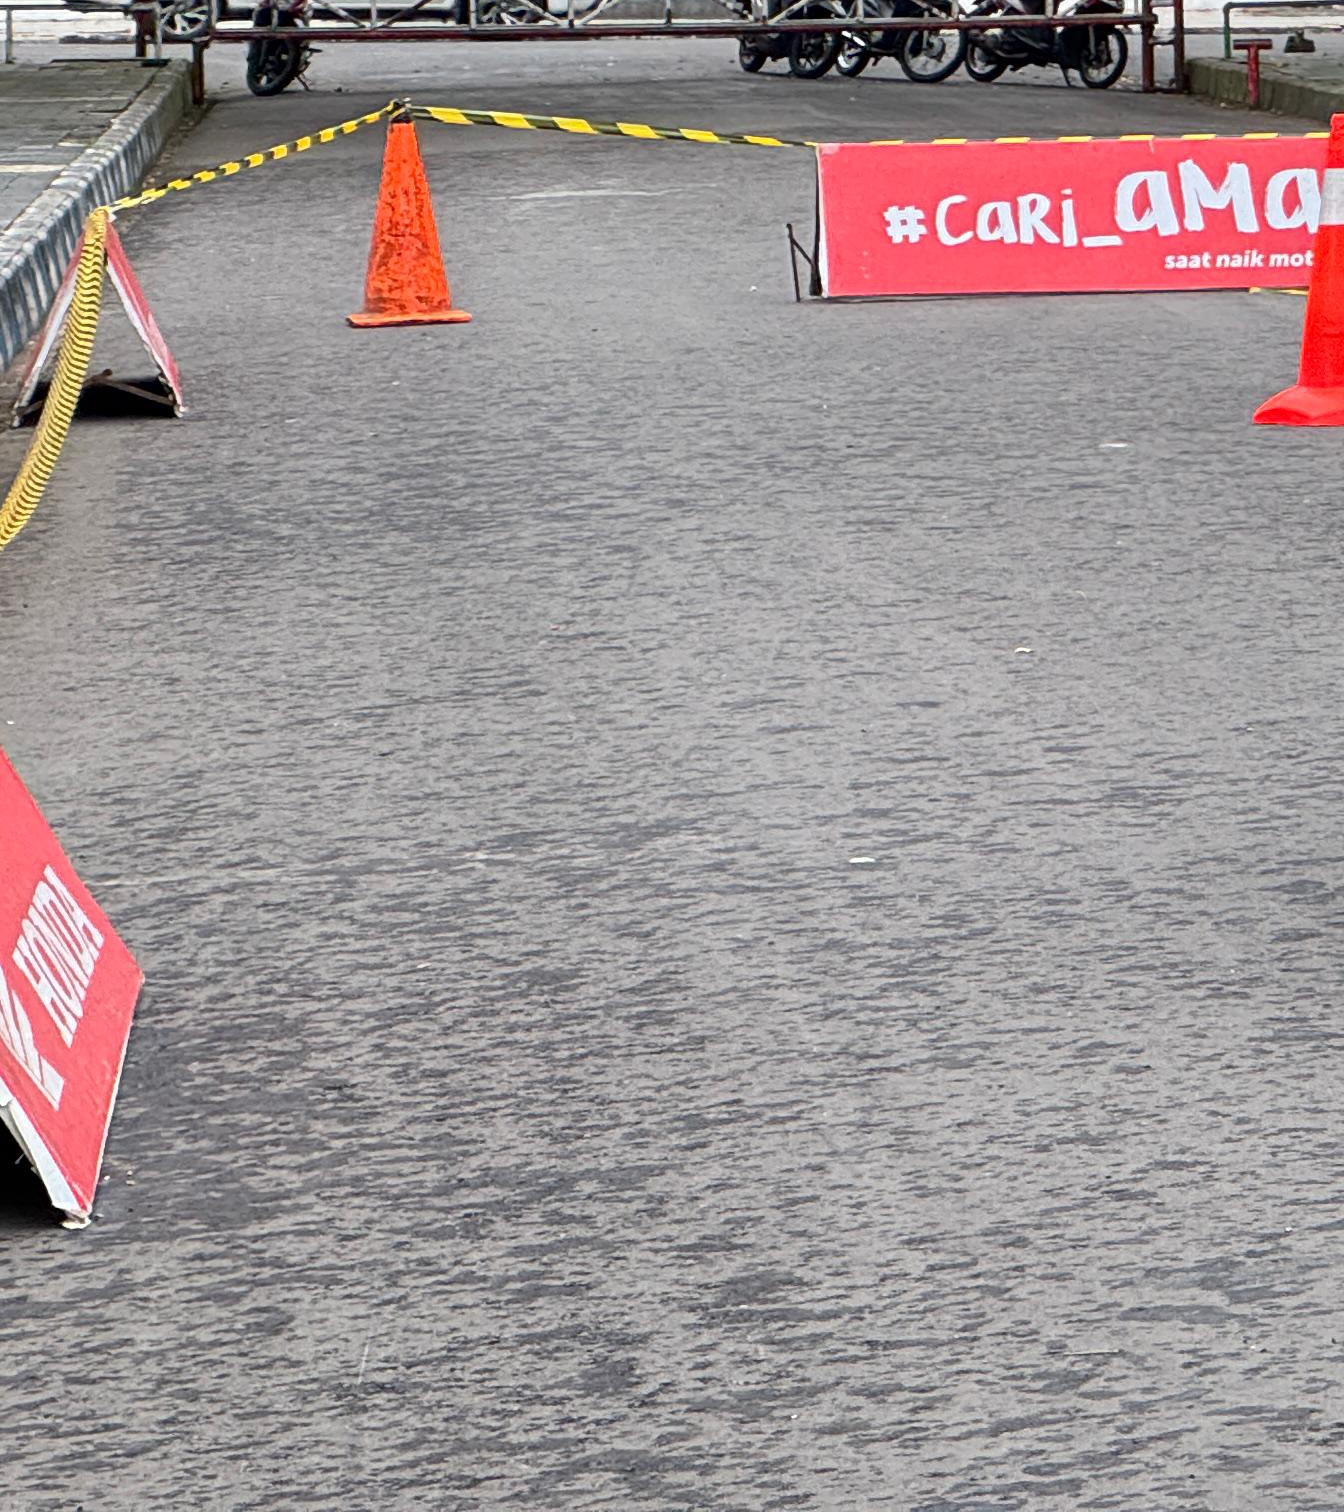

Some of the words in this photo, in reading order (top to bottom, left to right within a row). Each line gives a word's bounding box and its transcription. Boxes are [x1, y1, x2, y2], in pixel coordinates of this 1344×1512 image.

[1164, 251, 1211, 270] saat
[1215, 249, 1264, 269] naik
[1268, 249, 1314, 268] mot
[12, 863, 105, 1049] HONDA
